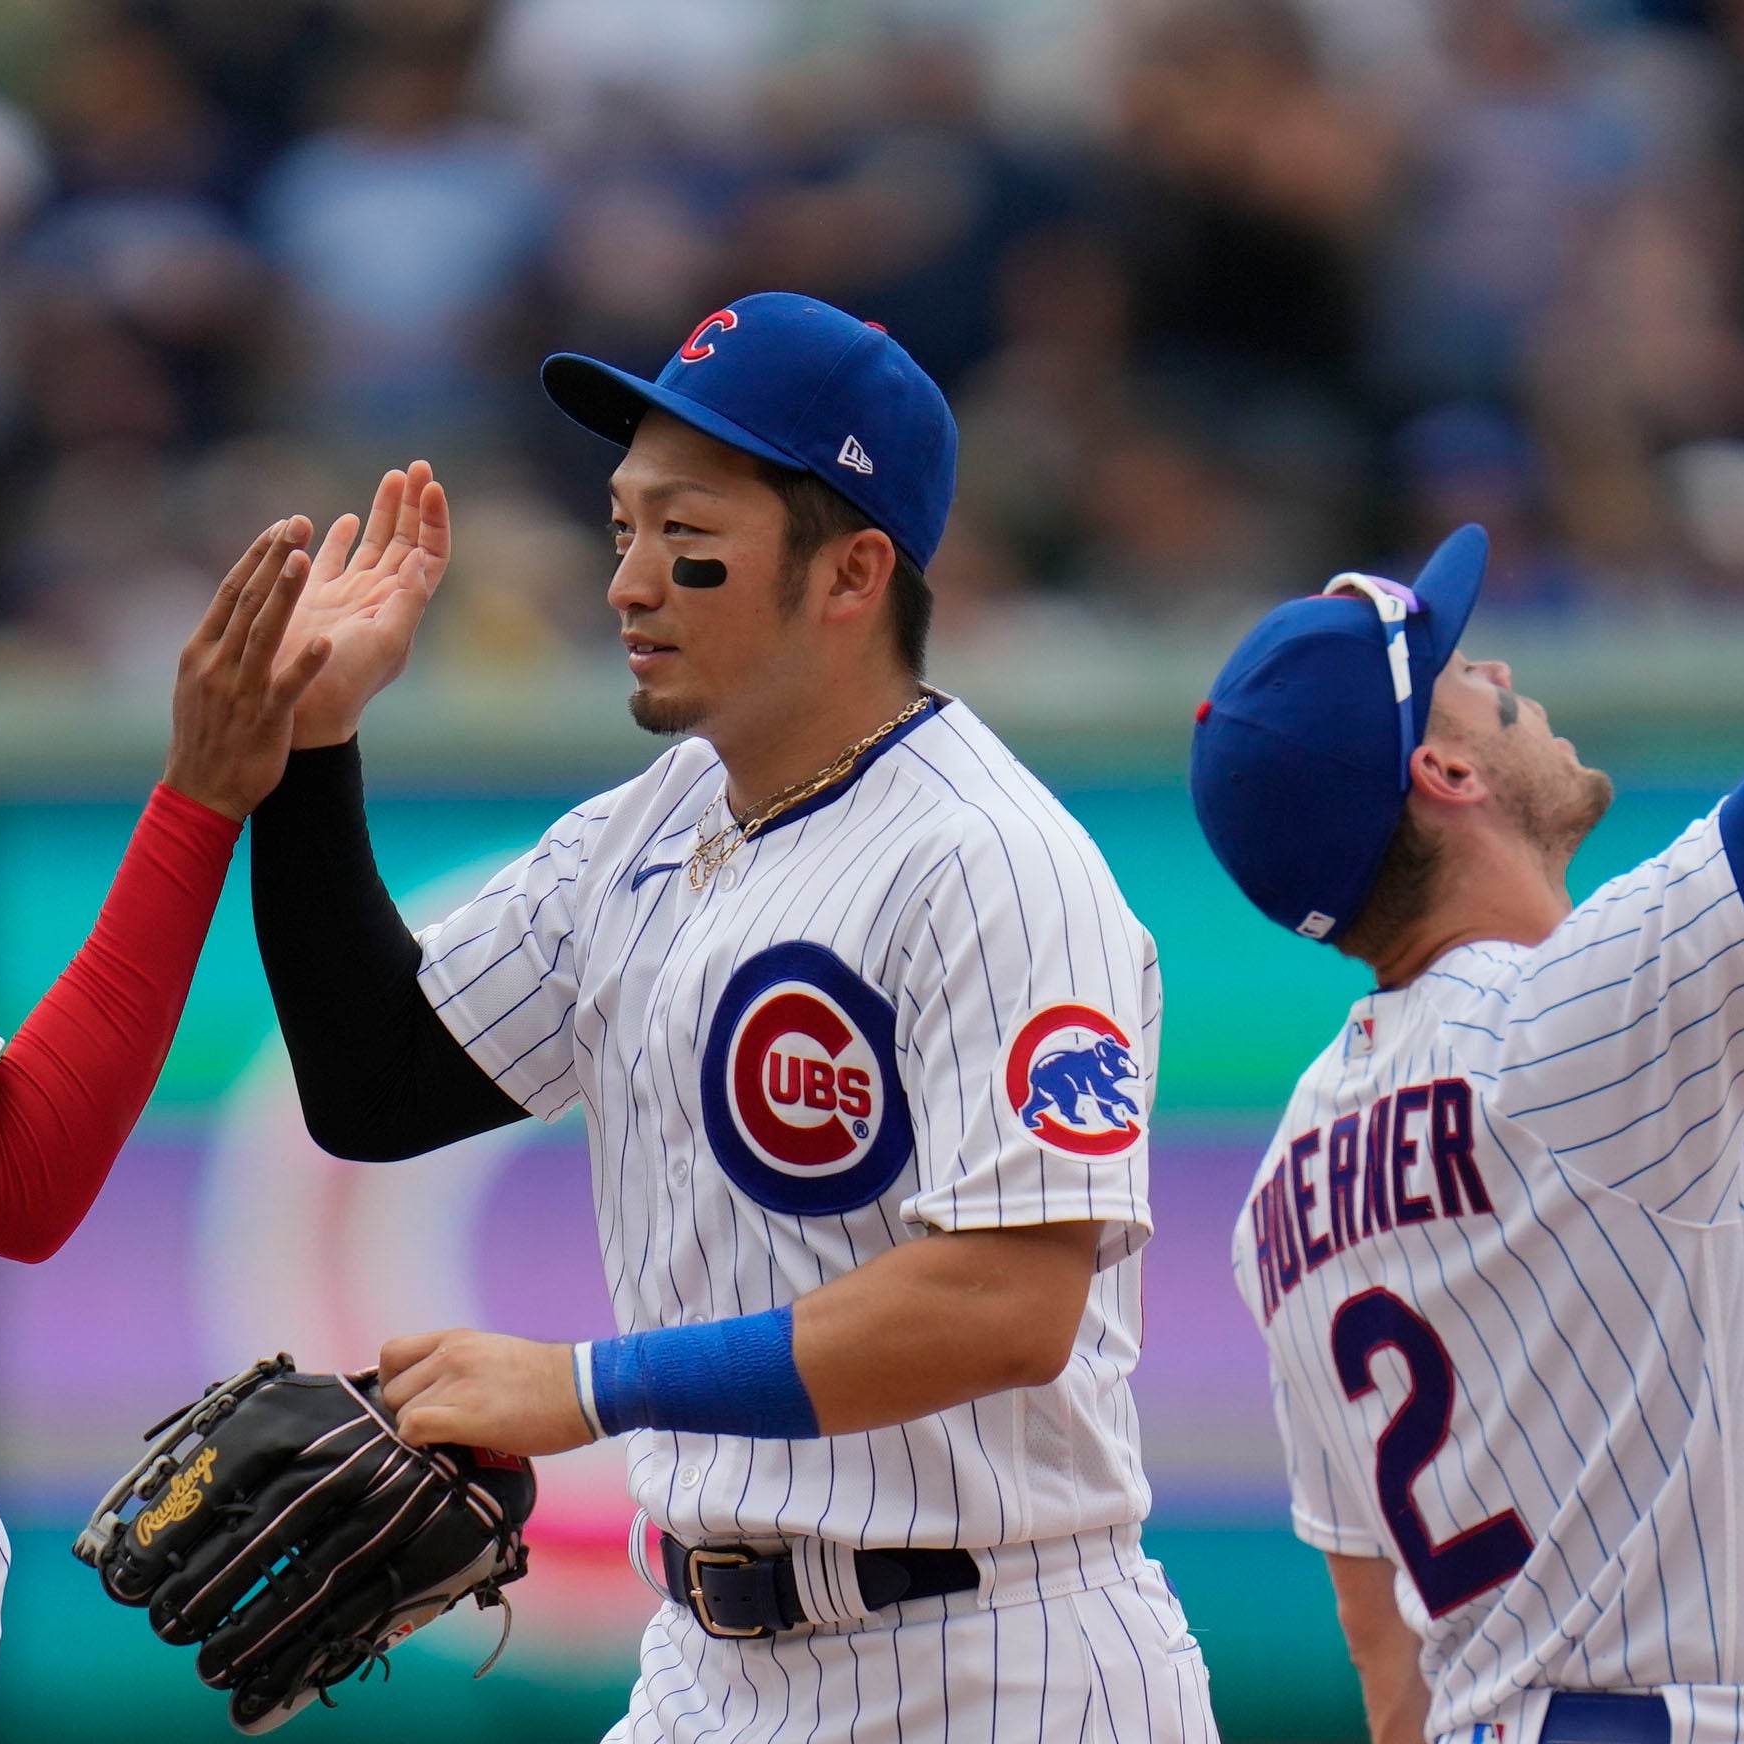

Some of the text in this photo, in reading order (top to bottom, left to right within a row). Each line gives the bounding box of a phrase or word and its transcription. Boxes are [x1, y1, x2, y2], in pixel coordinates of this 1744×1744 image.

[680, 309, 738, 363] C
[734, 992, 872, 1166] CUBS
[1251, 1076, 1495, 1328] HOERNER
[136, 1446, 218, 1547] Rawlings
[1330, 1285, 1536, 1620] 2
